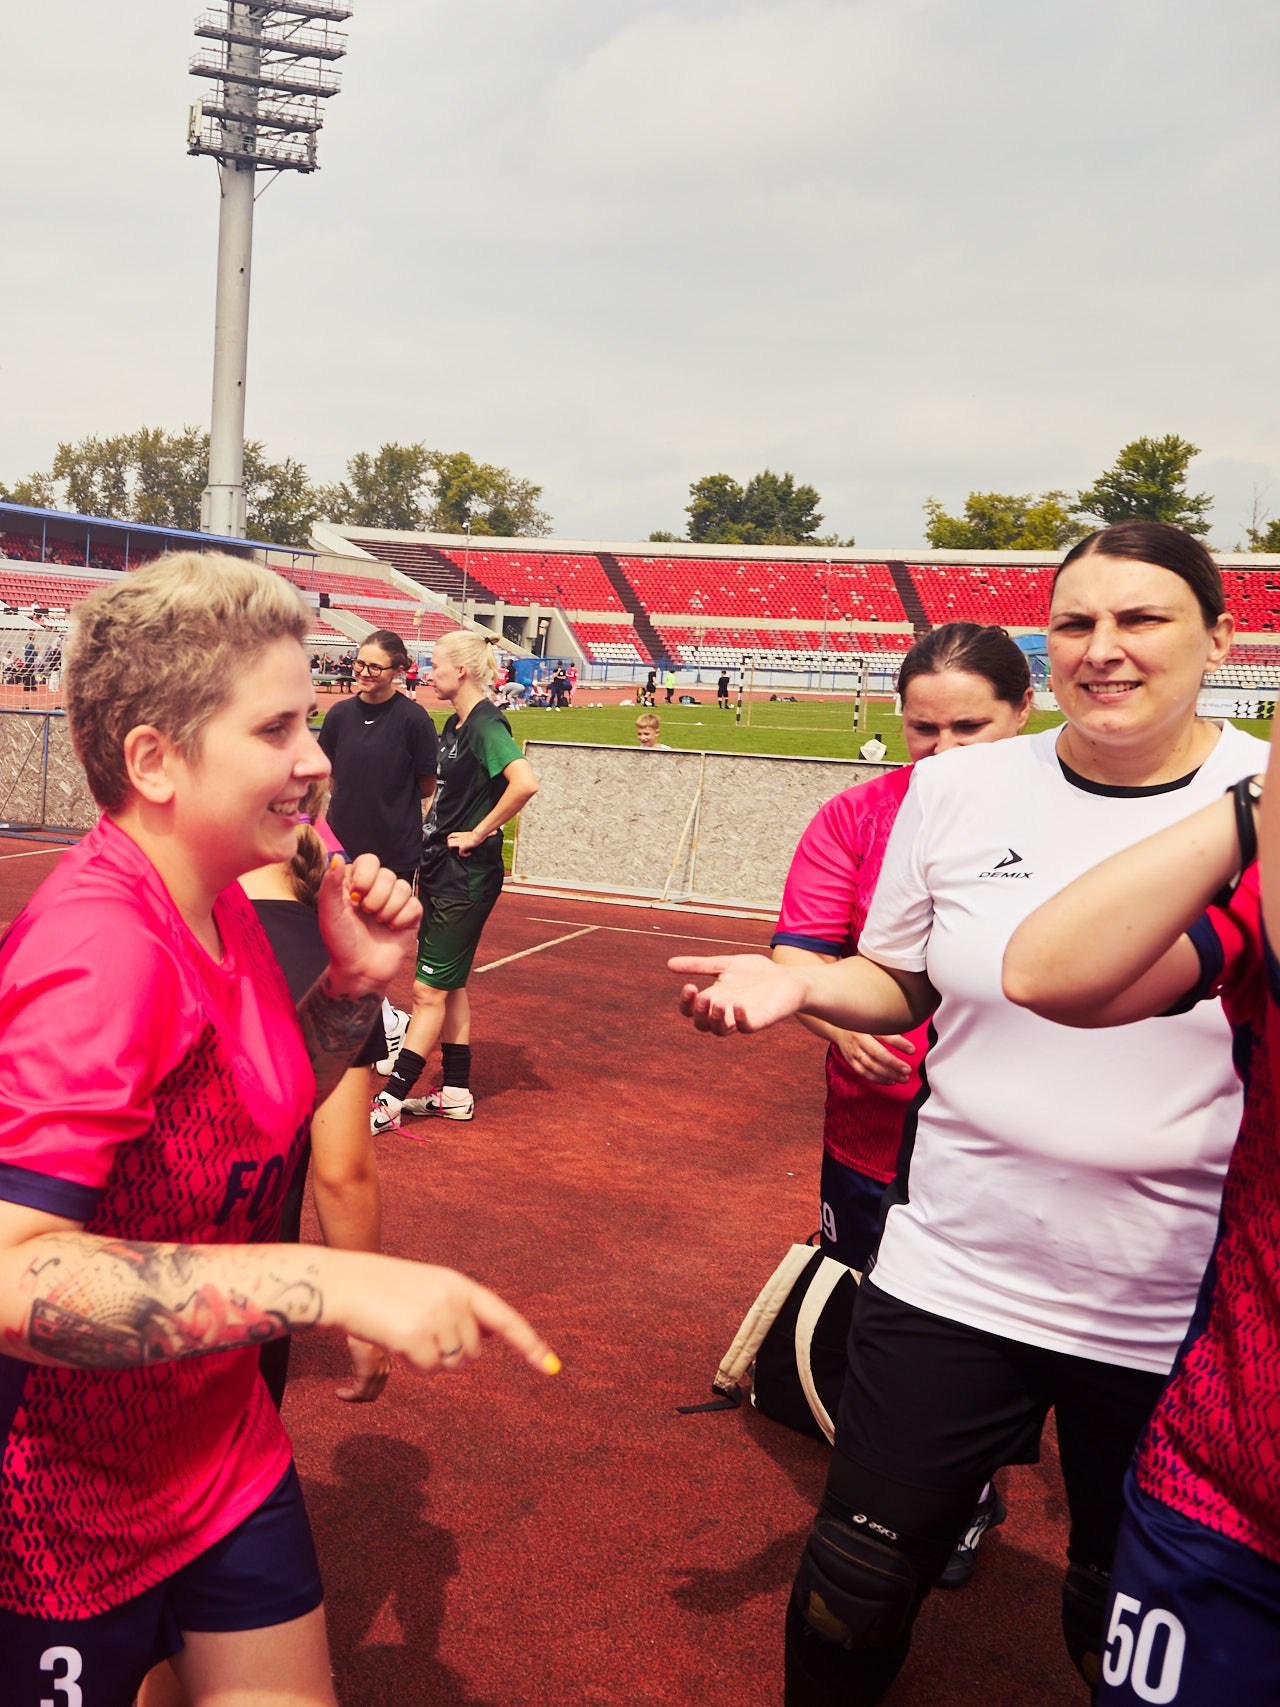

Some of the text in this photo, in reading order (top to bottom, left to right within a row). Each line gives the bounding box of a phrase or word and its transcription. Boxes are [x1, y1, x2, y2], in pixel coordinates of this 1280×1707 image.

[978, 871, 1035, 879] DEMIX
[820, 1200, 838, 1244] 9
[1102, 1591, 1187, 1705] 50
[39, 1645, 83, 1707] 3
